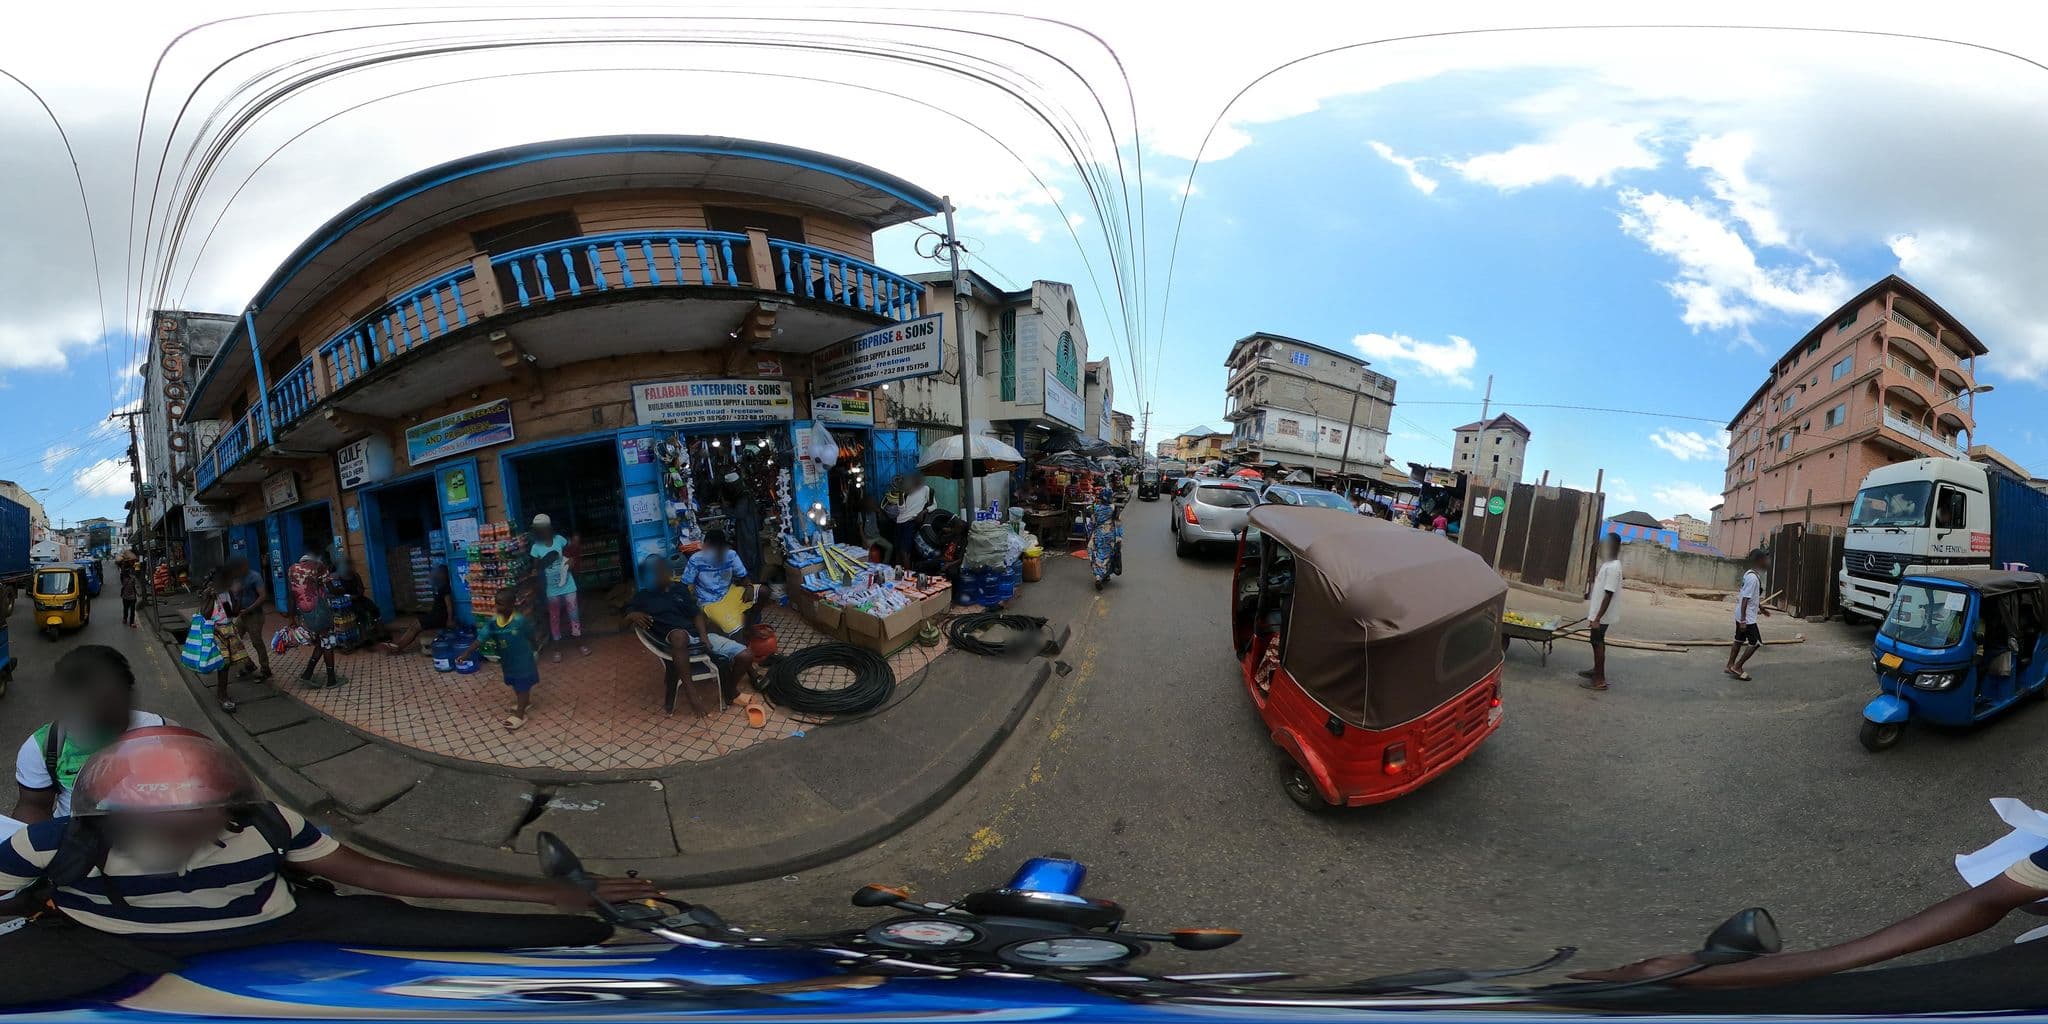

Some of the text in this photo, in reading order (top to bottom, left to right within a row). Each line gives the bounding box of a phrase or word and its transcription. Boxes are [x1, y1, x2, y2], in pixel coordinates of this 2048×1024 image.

[895, 330, 903, 341] &
[905, 321, 934, 339] SONS
[891, 342, 926, 356] ELECTRICALS
[876, 356, 911, 368] Freetown
[644, 383, 781, 401] FALABAH ENTERPRISE & SONS
[648, 402, 674, 412] BUILDING
[674, 399, 704, 409] MATERIALS
[339, 443, 362, 465] GULF
[341, 470, 353, 479] SOLD
[353, 466, 364, 475] HERE
